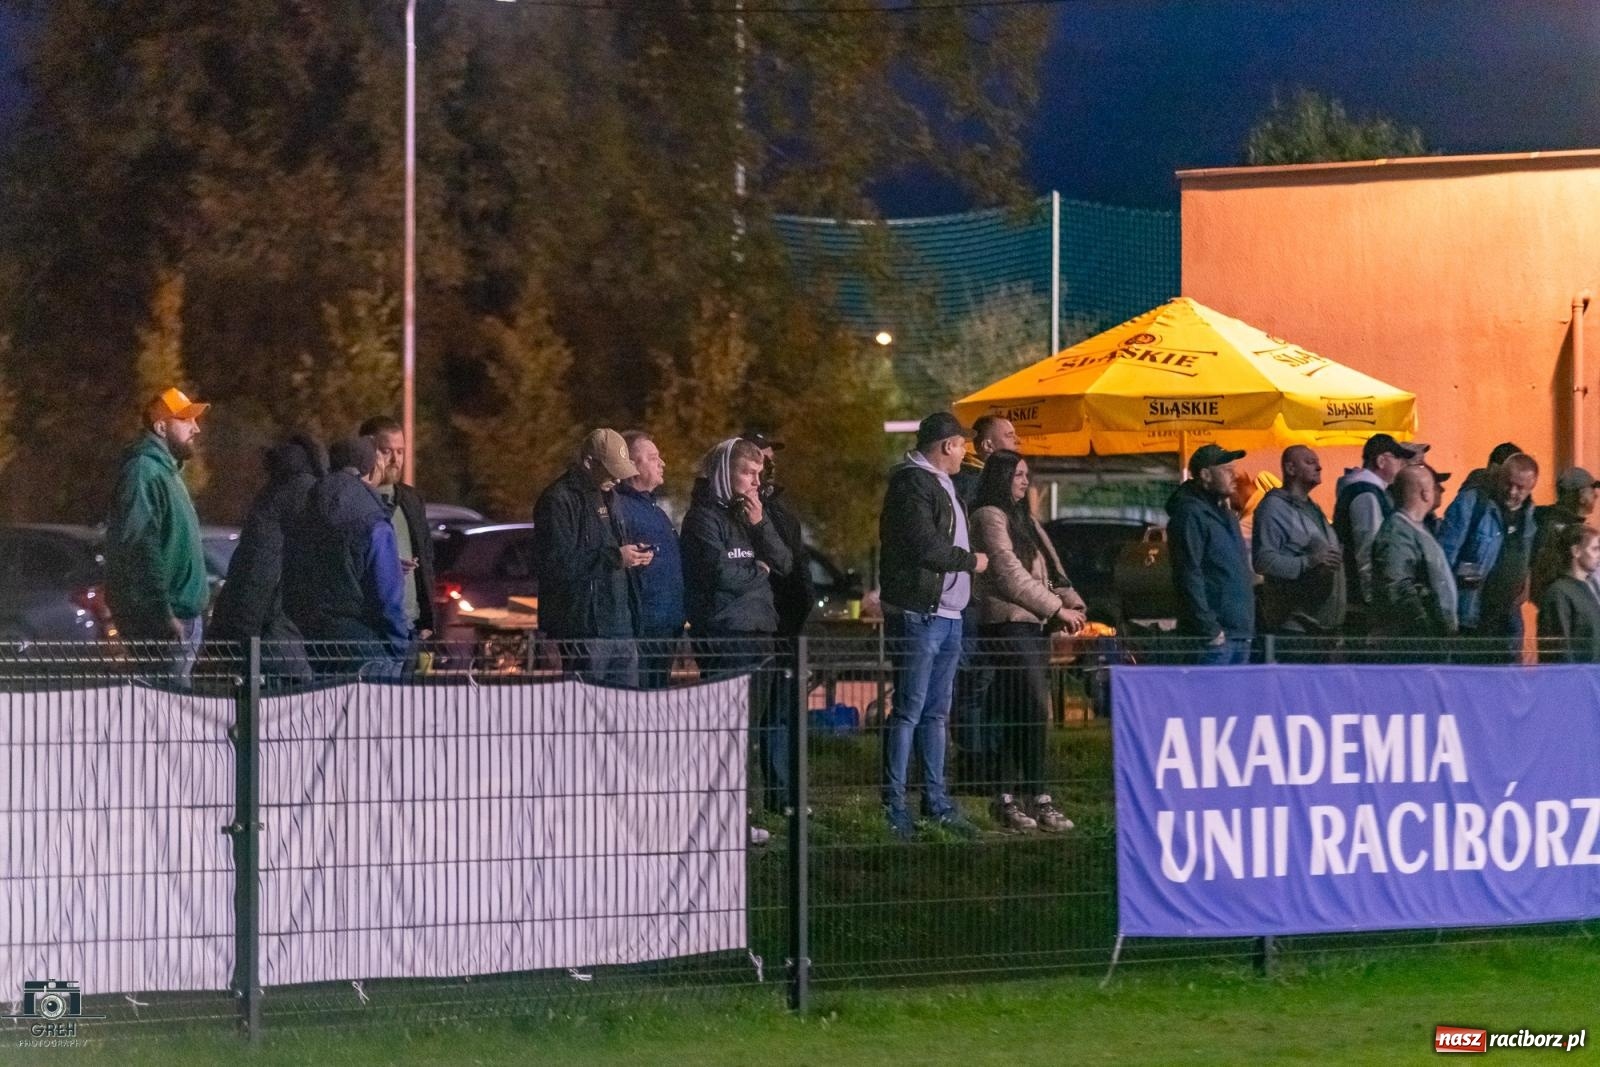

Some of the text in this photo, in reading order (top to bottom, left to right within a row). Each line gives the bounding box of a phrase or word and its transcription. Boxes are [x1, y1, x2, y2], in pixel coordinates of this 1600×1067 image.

[1149, 399, 1219, 418] ŚLĄSKIE
[1326, 401, 1374, 418] ŚLĄSKIE
[1156, 714, 1469, 790] AKADEMIA
[1157, 781, 1600, 883] UNII RACIBÓRZ
